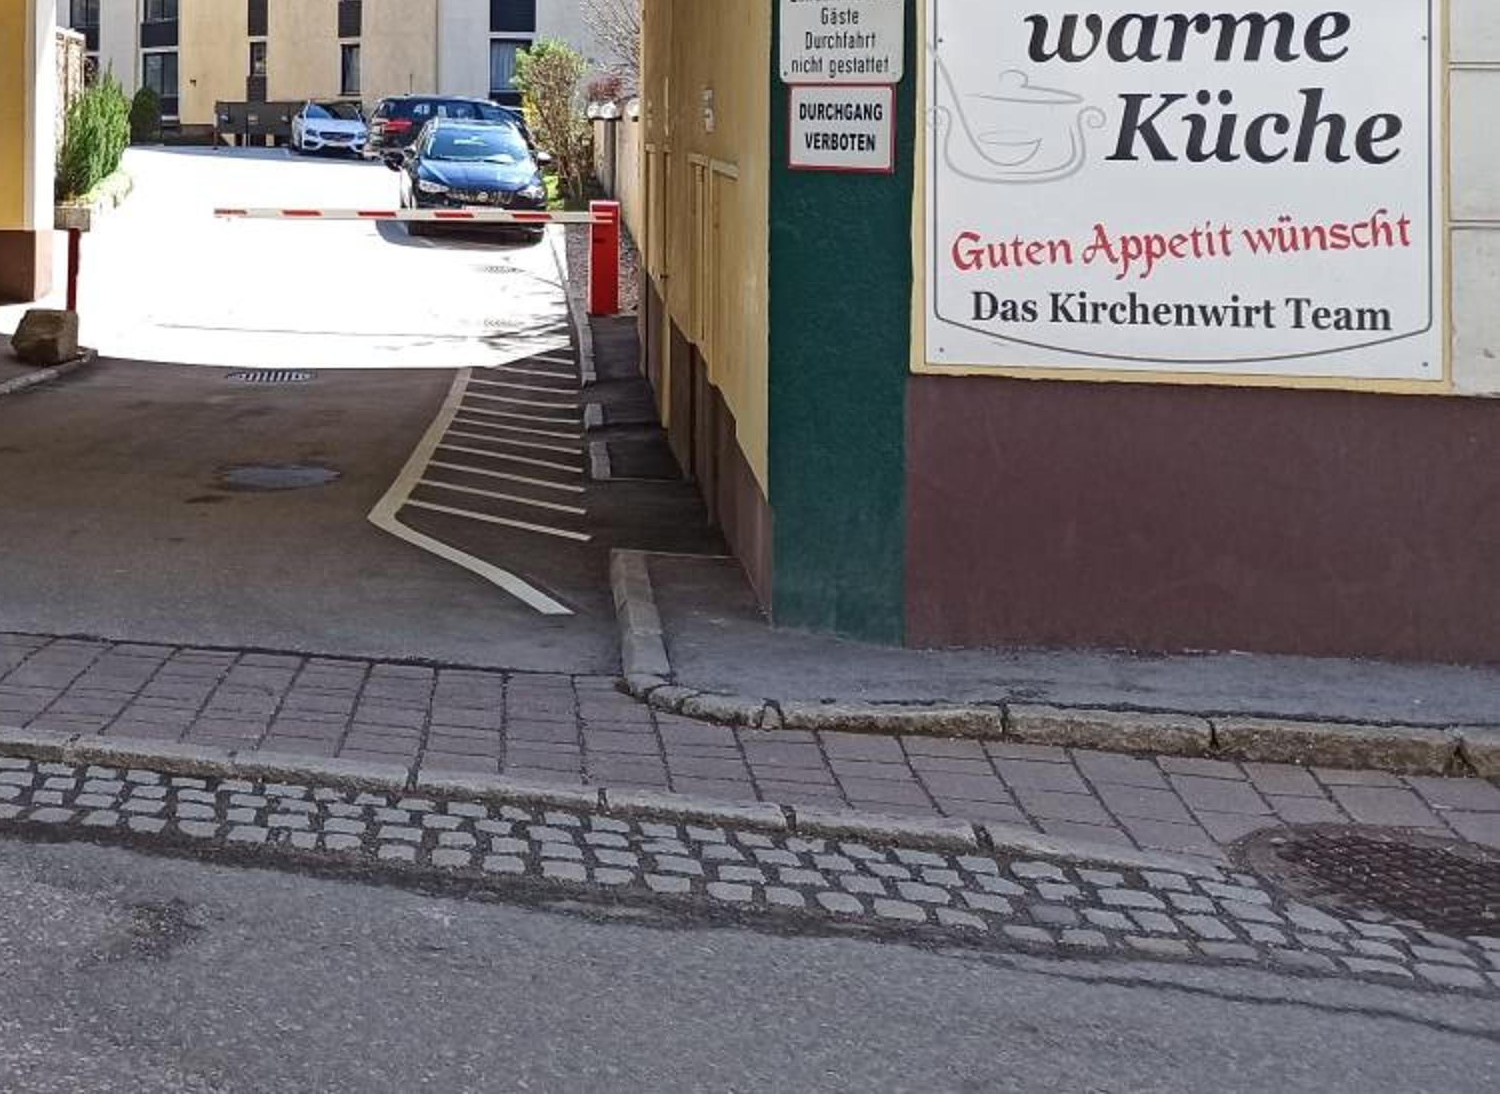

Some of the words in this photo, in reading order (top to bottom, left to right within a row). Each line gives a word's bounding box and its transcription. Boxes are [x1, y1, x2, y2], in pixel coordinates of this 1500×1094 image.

[821, 6, 860, 25] Gäste
[805, 30, 877, 50] Durchfahrt
[1024, 10, 1351, 63] warme
[791, 56, 824, 74] nicht
[829, 57, 890, 78] gestattet
[799, 102, 884, 121] DURCHGANG
[1104, 86, 1403, 165] Küche
[804, 132, 876, 152] VERBOTEN
[951, 231, 1073, 271] Guten
[1083, 220, 1232, 280] Appetit
[1241, 209, 1412, 256] wünscht
[971, 290, 1039, 324] Das
[1049, 291, 1277, 329] Kirchenwirt
[1285, 297, 1392, 331] Team
